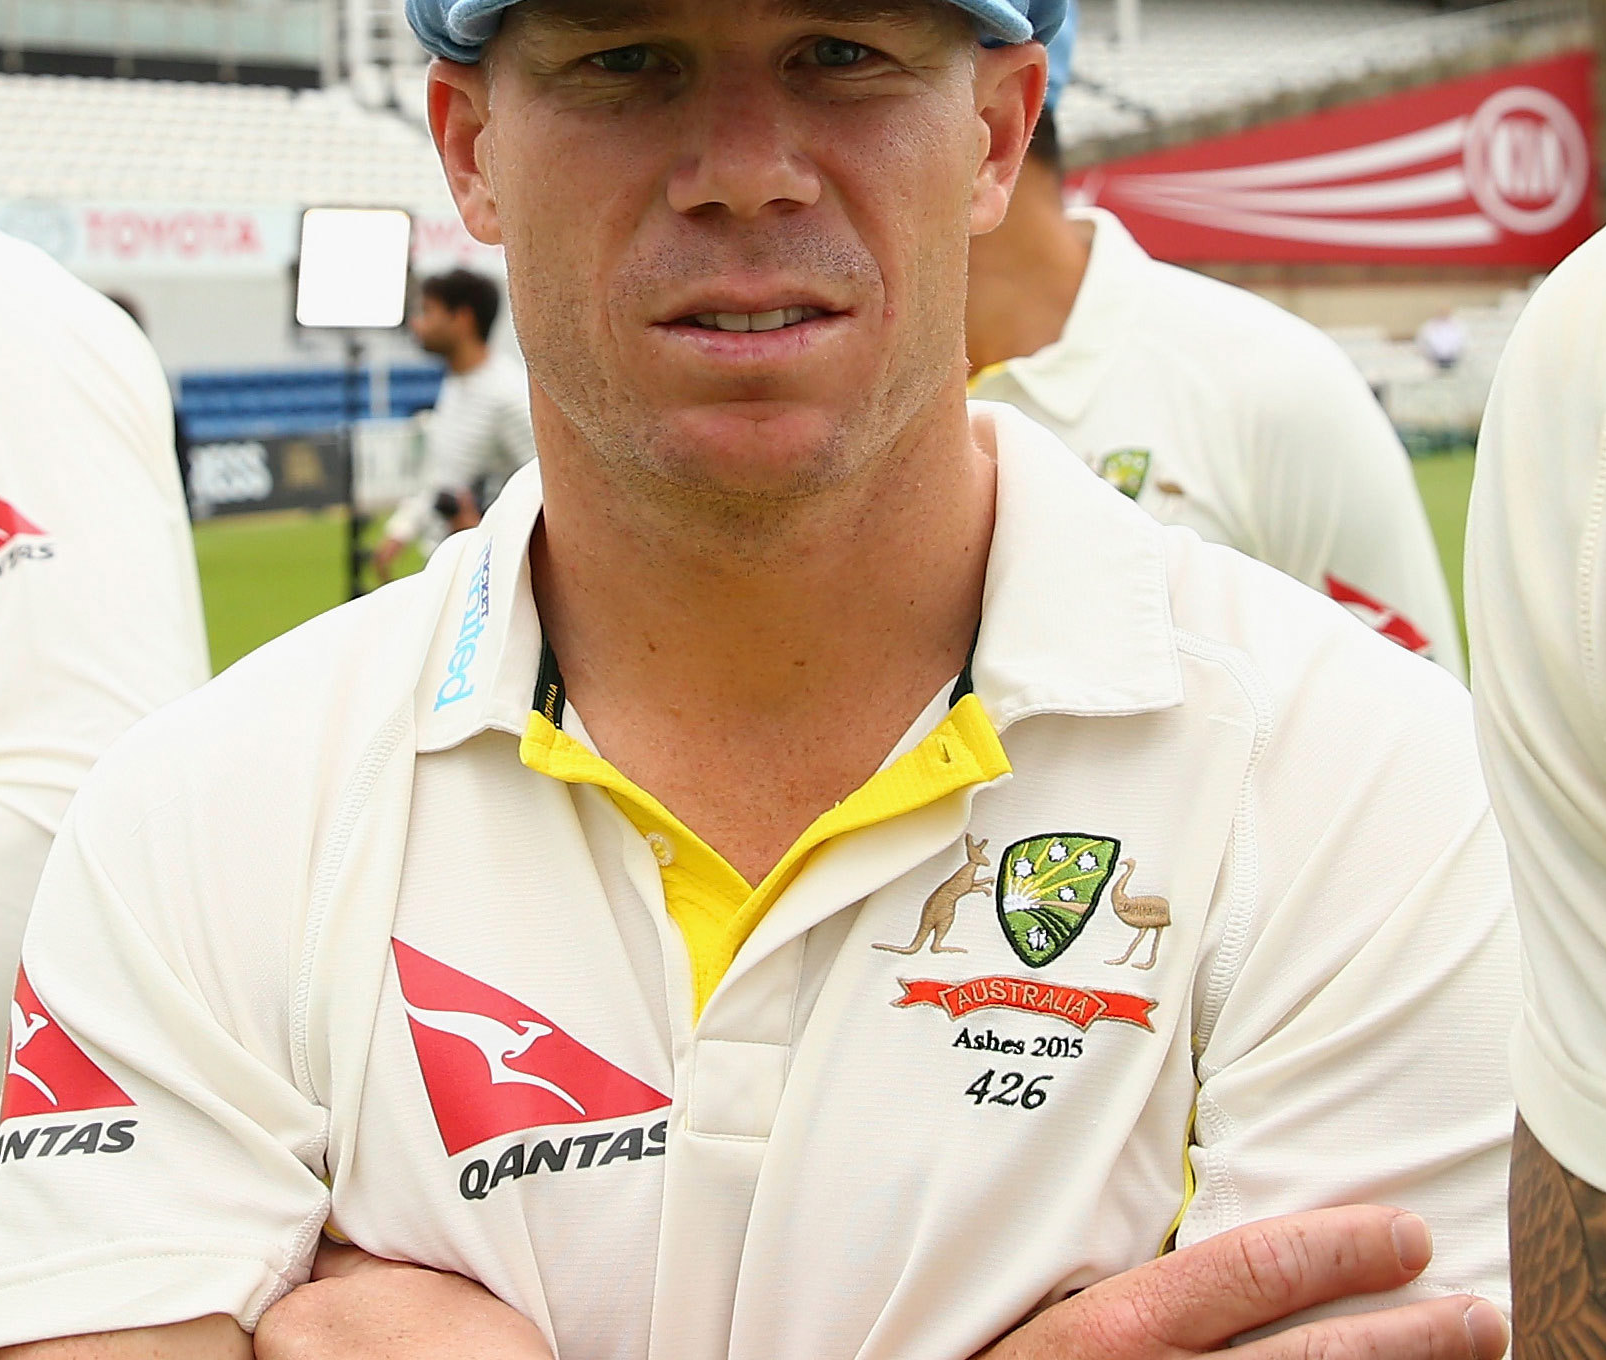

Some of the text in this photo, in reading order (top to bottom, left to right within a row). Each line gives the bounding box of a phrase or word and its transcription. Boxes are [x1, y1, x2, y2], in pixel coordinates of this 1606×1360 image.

[84, 210, 264, 259] TOYOTA
[957, 980, 1089, 1019] AUSTRALIA
[952, 1027, 1084, 1058] Ashes 2015
[965, 1068, 1054, 1110] 426
[459, 1120, 667, 1200] QANTAS
